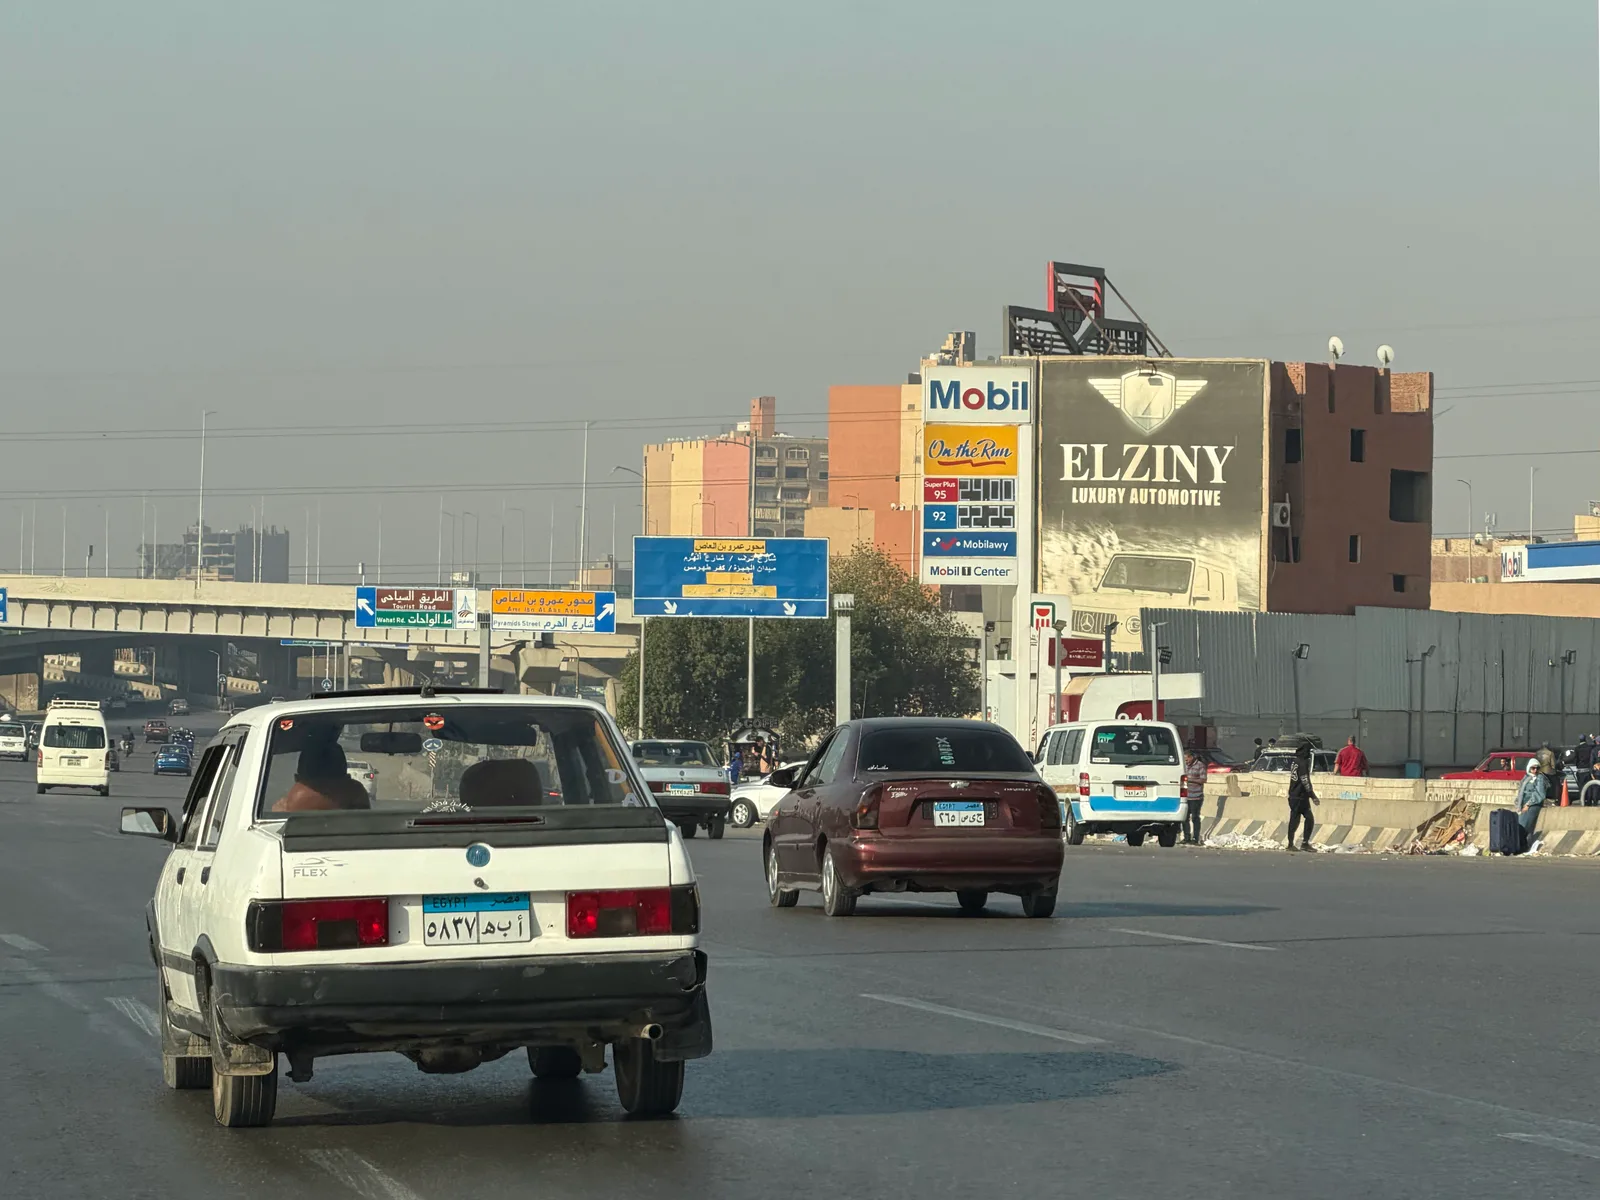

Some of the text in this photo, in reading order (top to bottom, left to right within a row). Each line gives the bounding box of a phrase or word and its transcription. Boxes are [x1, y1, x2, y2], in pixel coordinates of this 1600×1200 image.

[930, 380, 1029, 411] Mobil
[928, 438, 1012, 460] On the Run
[1059, 443, 1235, 484] ELZINY
[934, 479, 1014, 502] 95 24.00
[1072, 487, 1221, 506] LUXURY AUTOMOTIVE
[932, 505, 1014, 528] 92 22.25
[963, 540, 1009, 551] Mobilawy
[930, 567, 960, 576] Mobil
[974, 567, 1010, 576] Center
[1501, 552, 1523, 576] Mobil
[419, 591, 449, 604] الطريق
[567, 598, 593, 607] محور
[543, 618, 594, 630] شارع الهرم
[293, 868, 328, 878] FLEX
[433, 896, 468, 908] EGYPT
[490, 895, 520, 907] مصر
[427, 916, 476, 940] ٥٨٣٧
